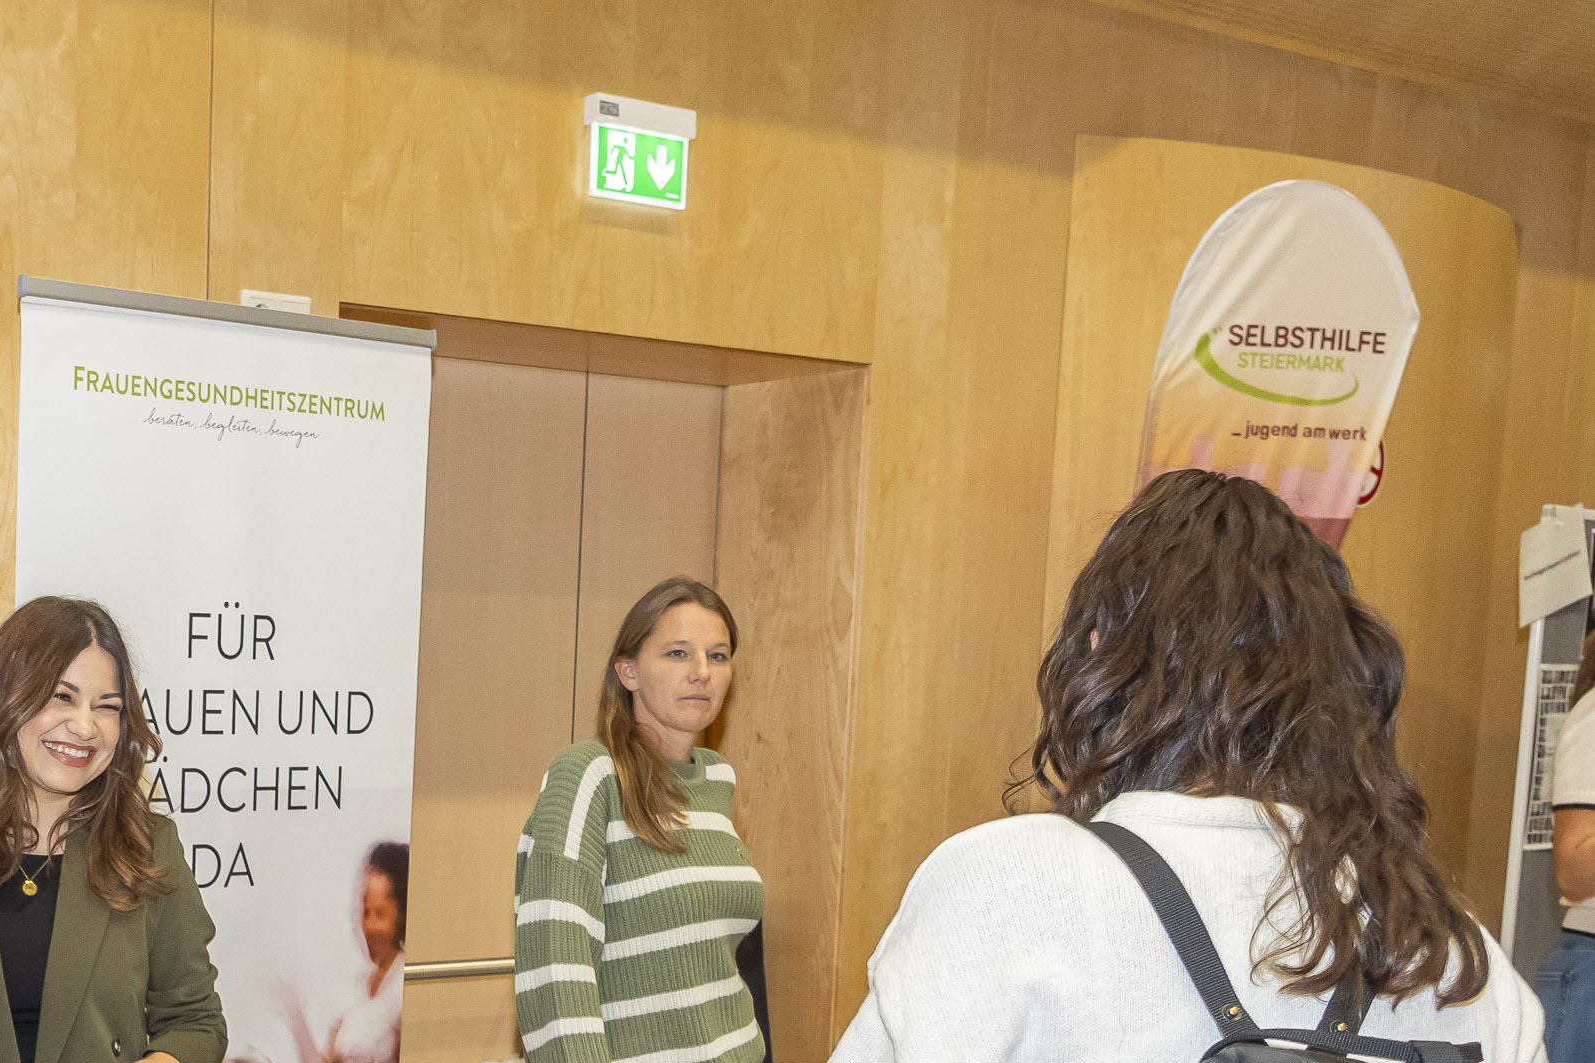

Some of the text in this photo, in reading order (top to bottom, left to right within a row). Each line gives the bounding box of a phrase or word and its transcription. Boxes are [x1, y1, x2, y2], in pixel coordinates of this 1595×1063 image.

[1228, 324, 1388, 354] SELBSTHILFE
[1237, 351, 1347, 372] STEIERMARK
[73, 365, 386, 421] FRAUENGESUNDHEITSZENTRUM
[264, 419, 320, 449] bewegen
[1302, 425, 1326, 440] am
[1328, 426, 1367, 441] werk
[188, 601, 276, 660] FÜR
[141, 688, 374, 736] AUEN UND
[147, 756, 343, 814] ÄDCHEN
[192, 842, 255, 889] DA
